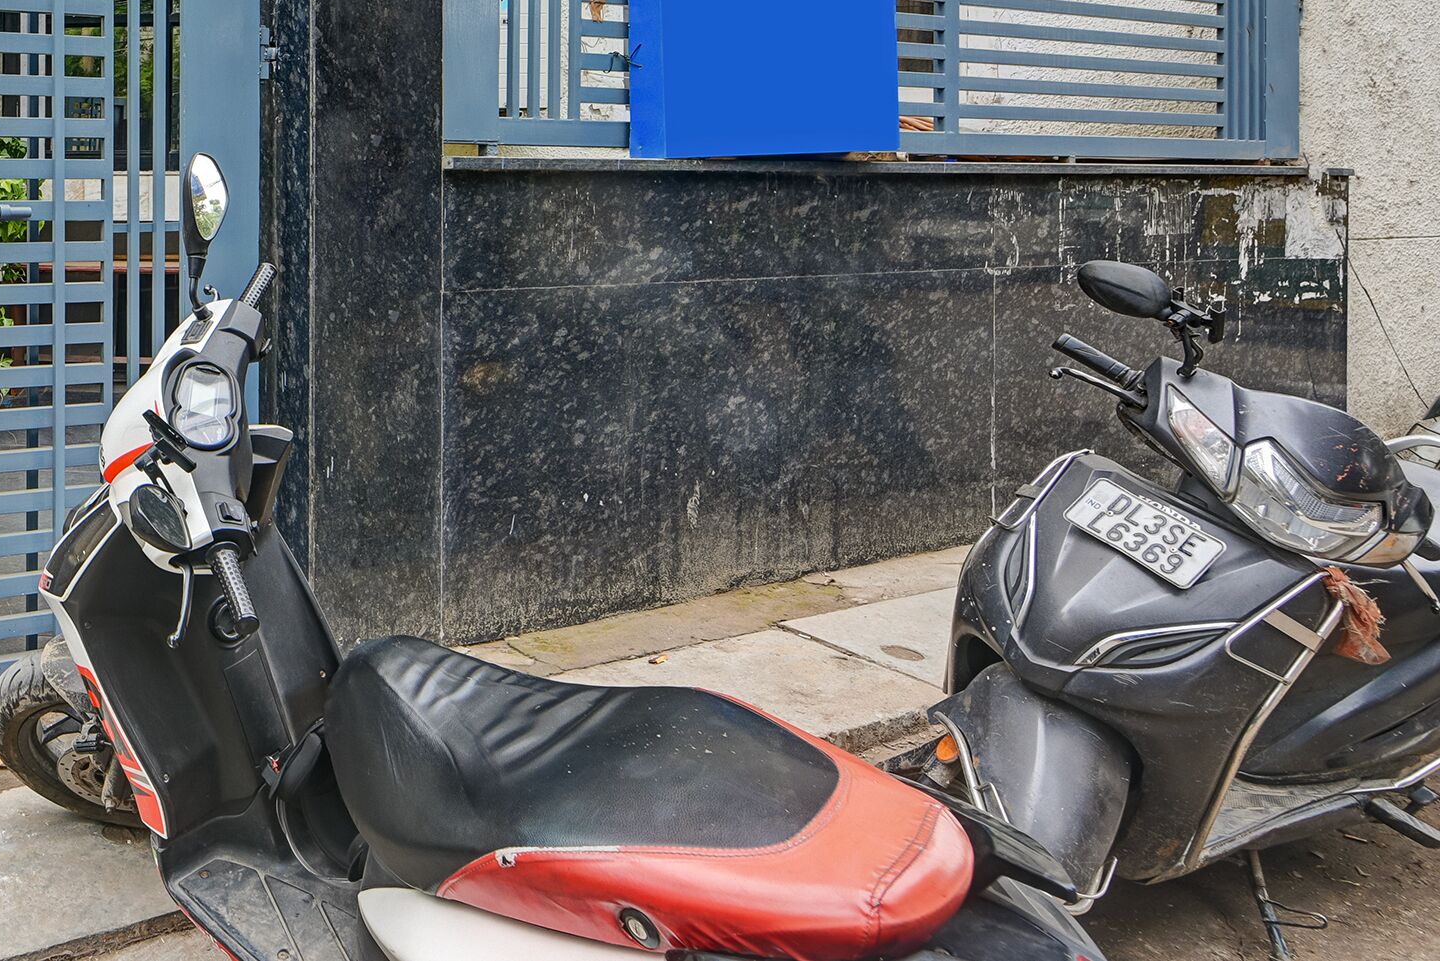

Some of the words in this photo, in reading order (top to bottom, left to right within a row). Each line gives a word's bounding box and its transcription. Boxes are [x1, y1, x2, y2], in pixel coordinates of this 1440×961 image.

[1084, 497, 1101, 510] IND
[1107, 493, 1207, 557] DL3SE
[1086, 511, 1184, 574] L6369
